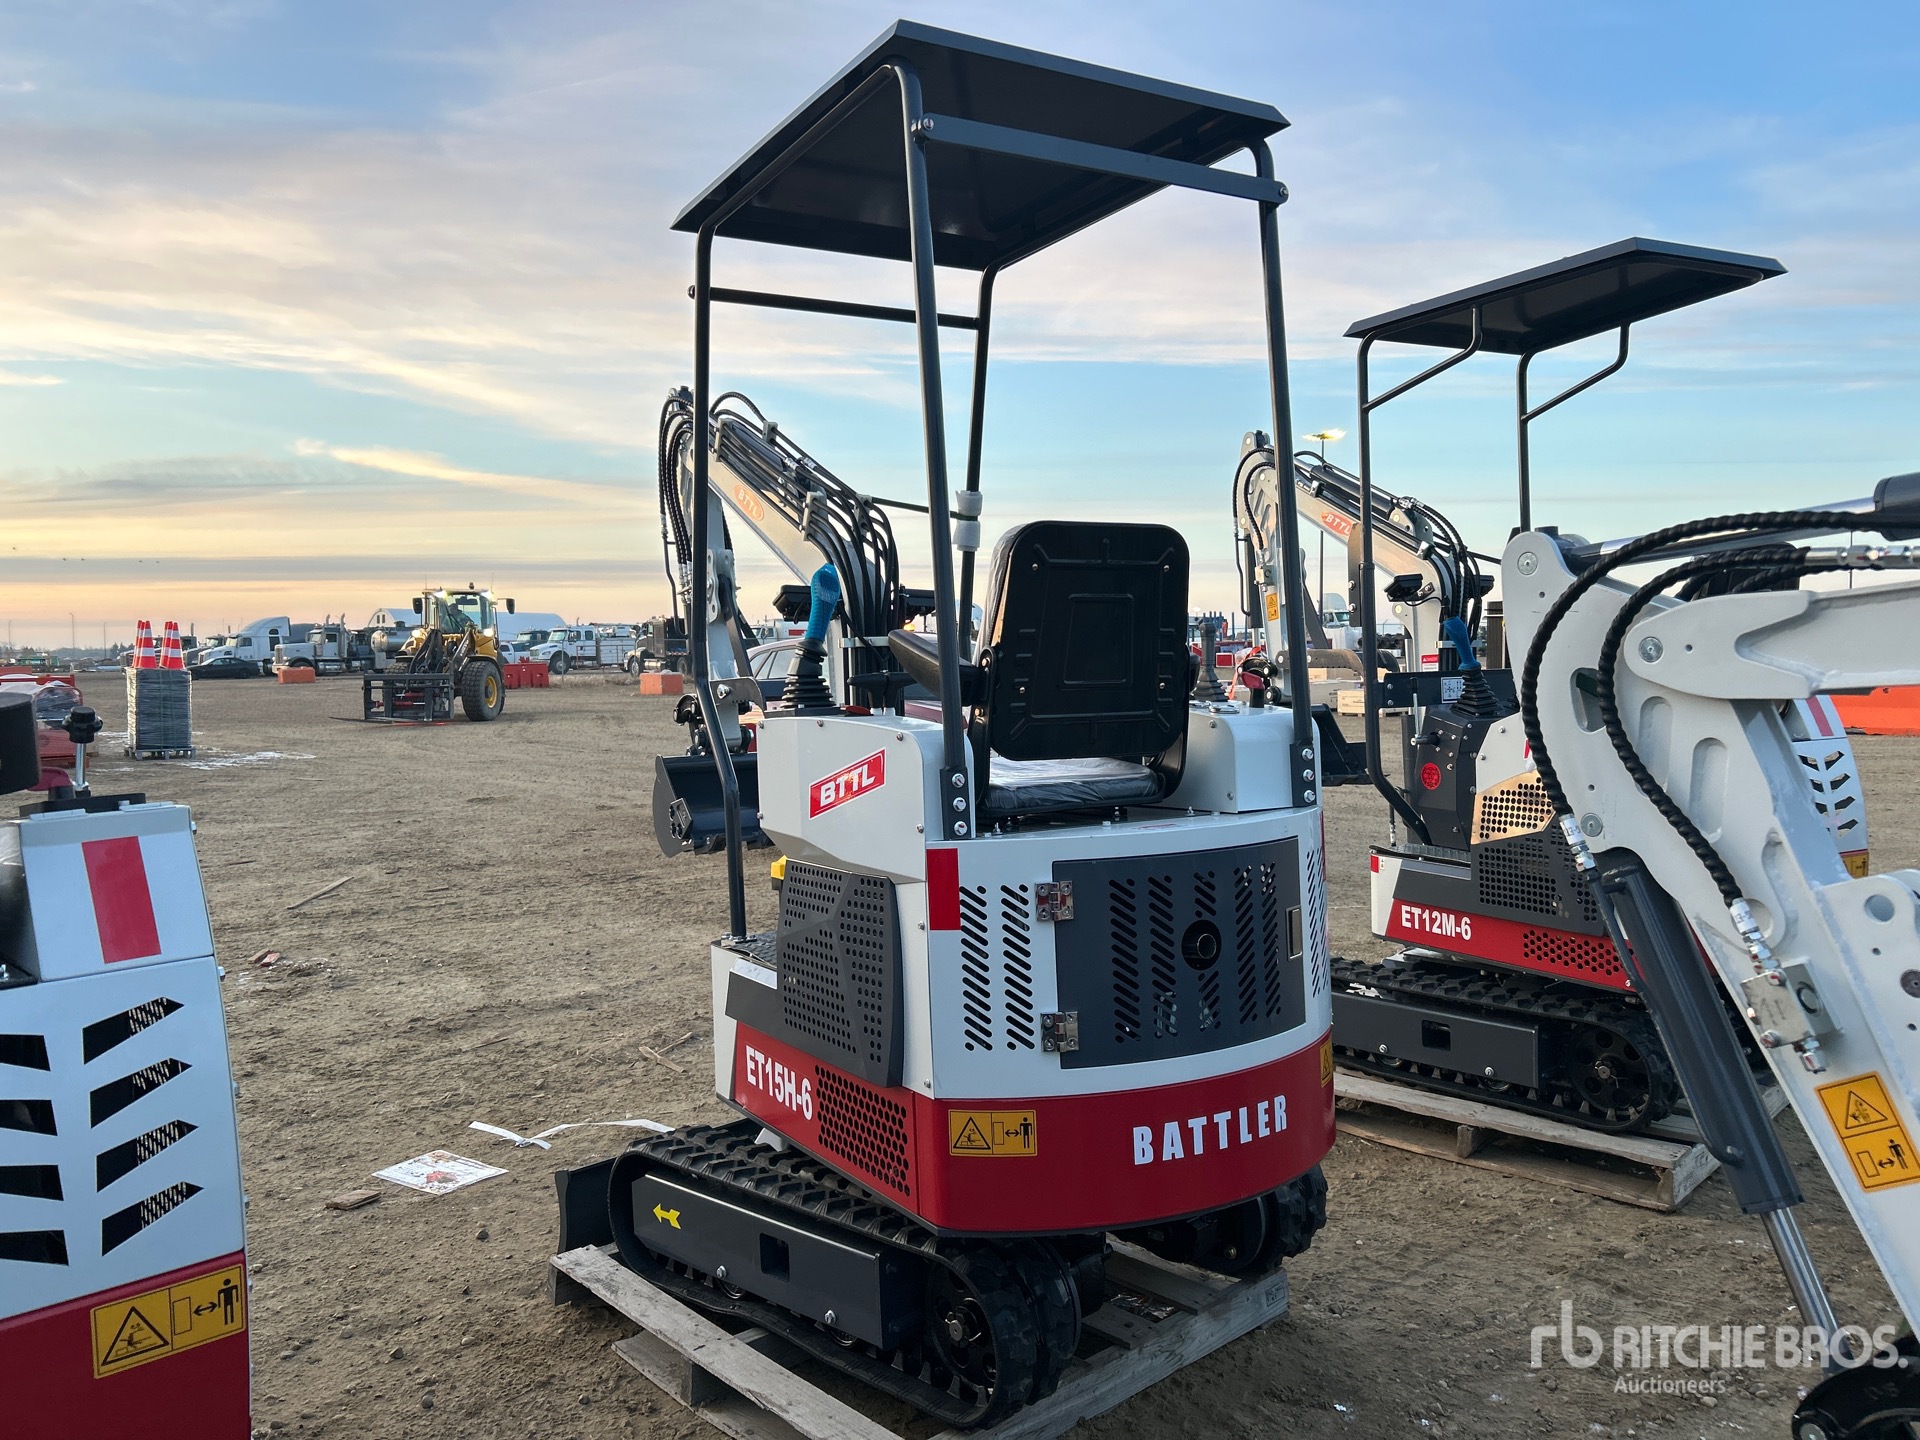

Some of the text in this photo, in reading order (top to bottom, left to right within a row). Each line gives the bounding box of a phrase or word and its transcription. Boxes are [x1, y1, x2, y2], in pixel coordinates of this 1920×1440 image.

[1326, 513, 1350, 535] BTTL
[820, 763, 876, 808] BTTL
[1401, 904, 1472, 941] ET12M-6
[746, 1044, 813, 1121] ET15H-6
[1132, 1094, 1287, 1166] BATTLER
